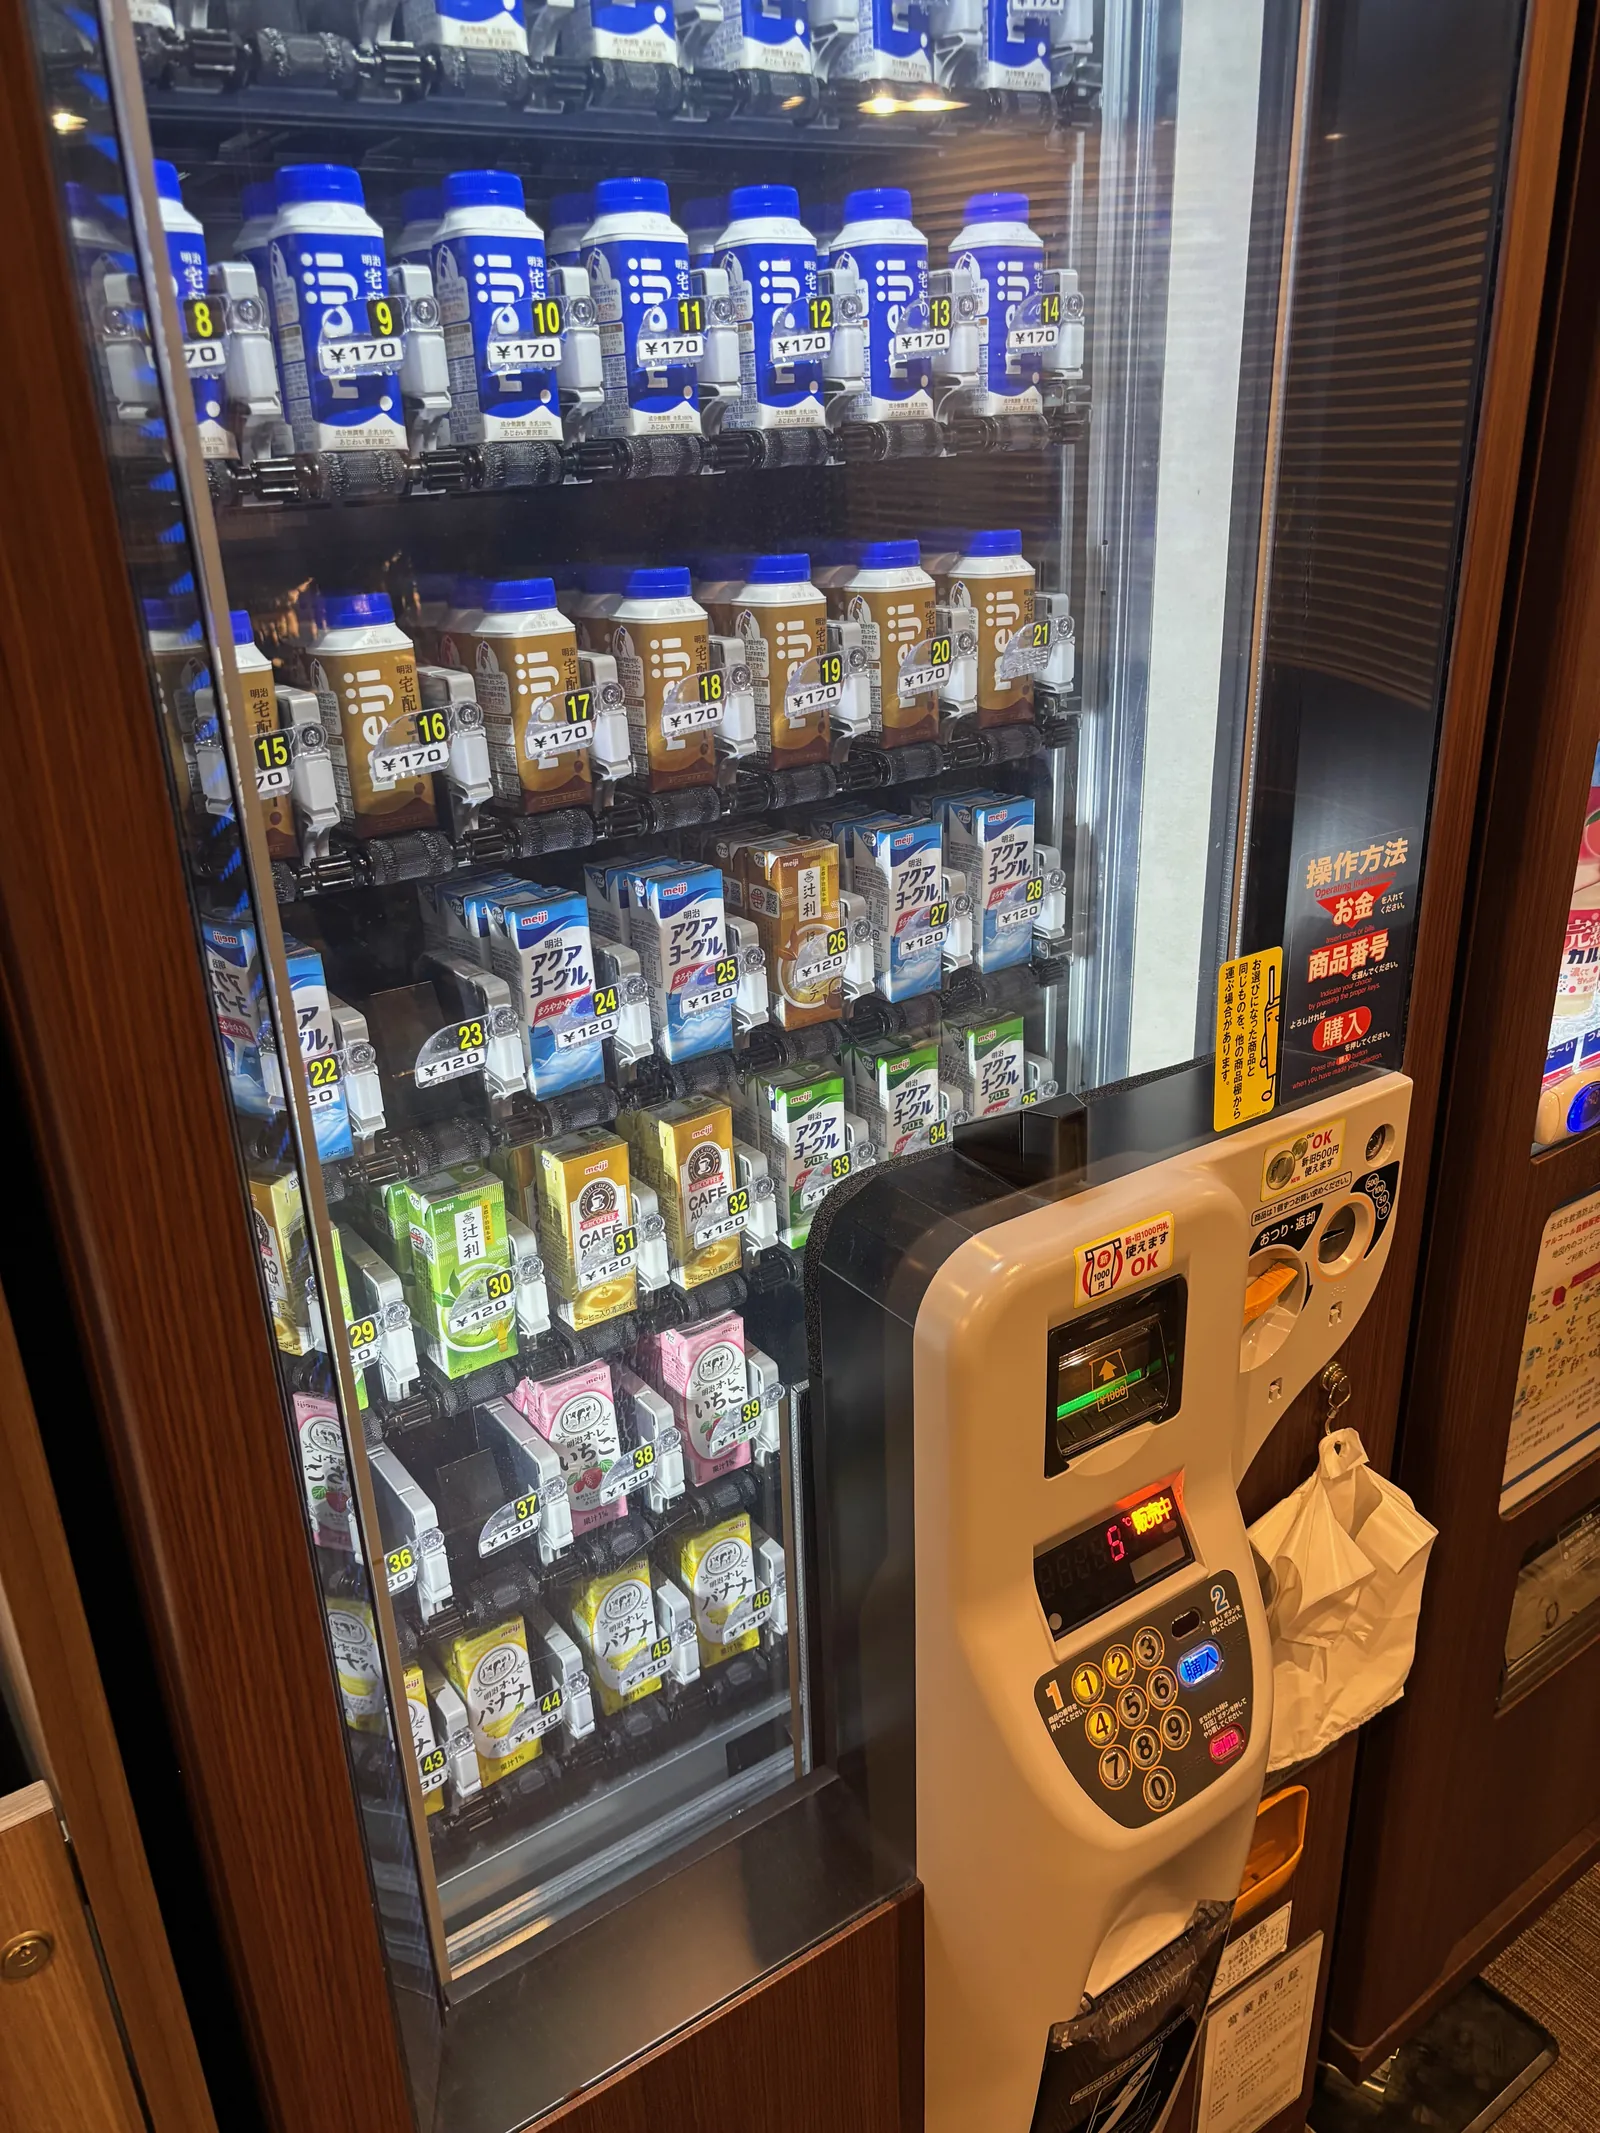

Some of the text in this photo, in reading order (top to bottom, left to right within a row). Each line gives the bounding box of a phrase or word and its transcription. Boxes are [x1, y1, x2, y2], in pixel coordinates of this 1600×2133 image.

[194, 302, 213, 337] 8
[376, 302, 393, 335] 9
[534, 302, 560, 333] 10
[680, 299, 701, 331] 11
[810, 301, 831, 328] 12
[932, 300, 949, 326] 13
[1043, 298, 1058, 323] 14
[645, 340, 698, 355] ¥170
[777, 337, 826, 353] ¥170
[901, 334, 945, 348] ¥170
[1015, 331, 1055, 344] ¥170
[330, 343, 396, 363] ¥170
[496, 343, 555, 359] ¥170
[1034, 623, 1047, 645] 21
[933, 640, 950, 664] 20
[397, 665, 412, 673] 明治
[822, 659, 840, 683] 19
[905, 668, 945, 687] ¥170
[399, 676, 417, 712] 宅配
[701, 674, 722, 699] 18
[793, 688, 837, 707] ¥170
[568, 695, 589, 720] 17
[669, 707, 717, 727] ¥170
[419, 714, 445, 741] 16
[534, 727, 587, 748] ¥170
[259, 737, 287, 767] 15
[382, 749, 441, 771] ¥170
[895, 834, 914, 846] meiji
[783, 859, 799, 867] meiji
[1306, 838, 1408, 889] 操作方法
[664, 882, 687, 896] meiji
[803, 885, 816, 917] 辻利
[1026, 880, 1041, 901] 28
[1382, 892, 1404, 904] を入れて
[522, 911, 548, 925] meiji
[930, 903, 946, 926] 27
[1003, 906, 1037, 923] ¥120
[1334, 891, 1374, 924] お金
[671, 917, 718, 944] アクア
[829, 931, 846, 954] 26
[906, 932, 943, 950] ¥120
[544, 938, 562, 948] 明治
[669, 936, 724, 966] ヨーグル
[531, 945, 582, 975] アクア
[802, 957, 842, 977] ¥120
[1307, 931, 1389, 983] 商品番号
[531, 965, 588, 998] ヨーグル
[717, 960, 736, 984] 25
[595, 989, 616, 1015] 24
[688, 988, 733, 1008] ¥120
[1221, 968, 1234, 1085] 運ぶ場合があります。
[1247, 959, 1261, 1077] お選びになった商品と
[1290, 1011, 1326, 1029] よろしければ
[1322, 1012, 1362, 1048] 購入
[459, 1023, 483, 1049] 23
[564, 1020, 612, 1042] ¥120
[310, 1058, 338, 1085] 22
[425, 1053, 479, 1076] ¥120
[890, 1059, 910, 1072] meiji
[790, 1091, 812, 1104] meiji
[930, 1122, 946, 1143] 34
[1312, 1130, 1332, 1149] OK
[585, 1160, 608, 1175] meiji
[805, 1154, 828, 1167] アロエ
[833, 1158, 850, 1176] 33
[1302, 1144, 1339, 1167] 新旧500円
[1305, 1158, 1333, 1177] 使えます
[1367, 1178, 1377, 1187] 500
[1375, 1185, 1384, 1193] 100
[435, 1202, 454, 1214] meiji
[730, 1192, 747, 1214] 32
[1379, 1195, 1386, 1203] 50
[579, 1222, 622, 1249] CAFÉ
[703, 1217, 744, 1238] ¥120
[463, 1224, 479, 1258] 辻利
[616, 1233, 634, 1253] 31
[1126, 1232, 1168, 1259] 使えます
[586, 1256, 631, 1280] ¥120
[1094, 1269, 1110, 1281] 1000
[1131, 1250, 1159, 1276] OK
[489, 1274, 510, 1299] 30
[456, 1301, 506, 1328] ¥120
[350, 1321, 374, 1348] 29
[585, 1373, 607, 1386] meiji
[743, 1400, 759, 1421] 39
[719, 1420, 757, 1446] ¥130
[560, 1437, 616, 1470] いちご
[635, 1445, 654, 1467] 38
[607, 1470, 649, 1498] ¥130
[517, 1496, 536, 1519] 37
[486, 1520, 534, 1547] ¥130
[390, 1549, 411, 1573] 36
[753, 1590, 770, 1608] 46
[1210, 1585, 1230, 1615] 2
[728, 1611, 766, 1637] ¥130
[603, 1619, 653, 1656] バナナ
[1140, 1637, 1156, 1660] 3
[651, 1640, 671, 1660] 45
[627, 1659, 666, 1685] ¥130
[1111, 1652, 1127, 1678] 2
[1182, 1650, 1218, 1682] 購入
[1081, 1668, 1093, 1697] 1
[1154, 1676, 1169, 1698] 6
[477, 1683, 531, 1727] バナナ
[542, 1691, 560, 1714] 44
[1046, 1680, 1064, 1711] 1
[1125, 1693, 1140, 1718] 5
[514, 1714, 558, 1742] ¥130
[1096, 1713, 1109, 1739] 4
[1168, 1716, 1182, 1740] 9
[1137, 1734, 1152, 1759] 8
[424, 1750, 444, 1773] 43
[1105, 1754, 1120, 1781] 7
[1151, 1775, 1166, 1801] 0
